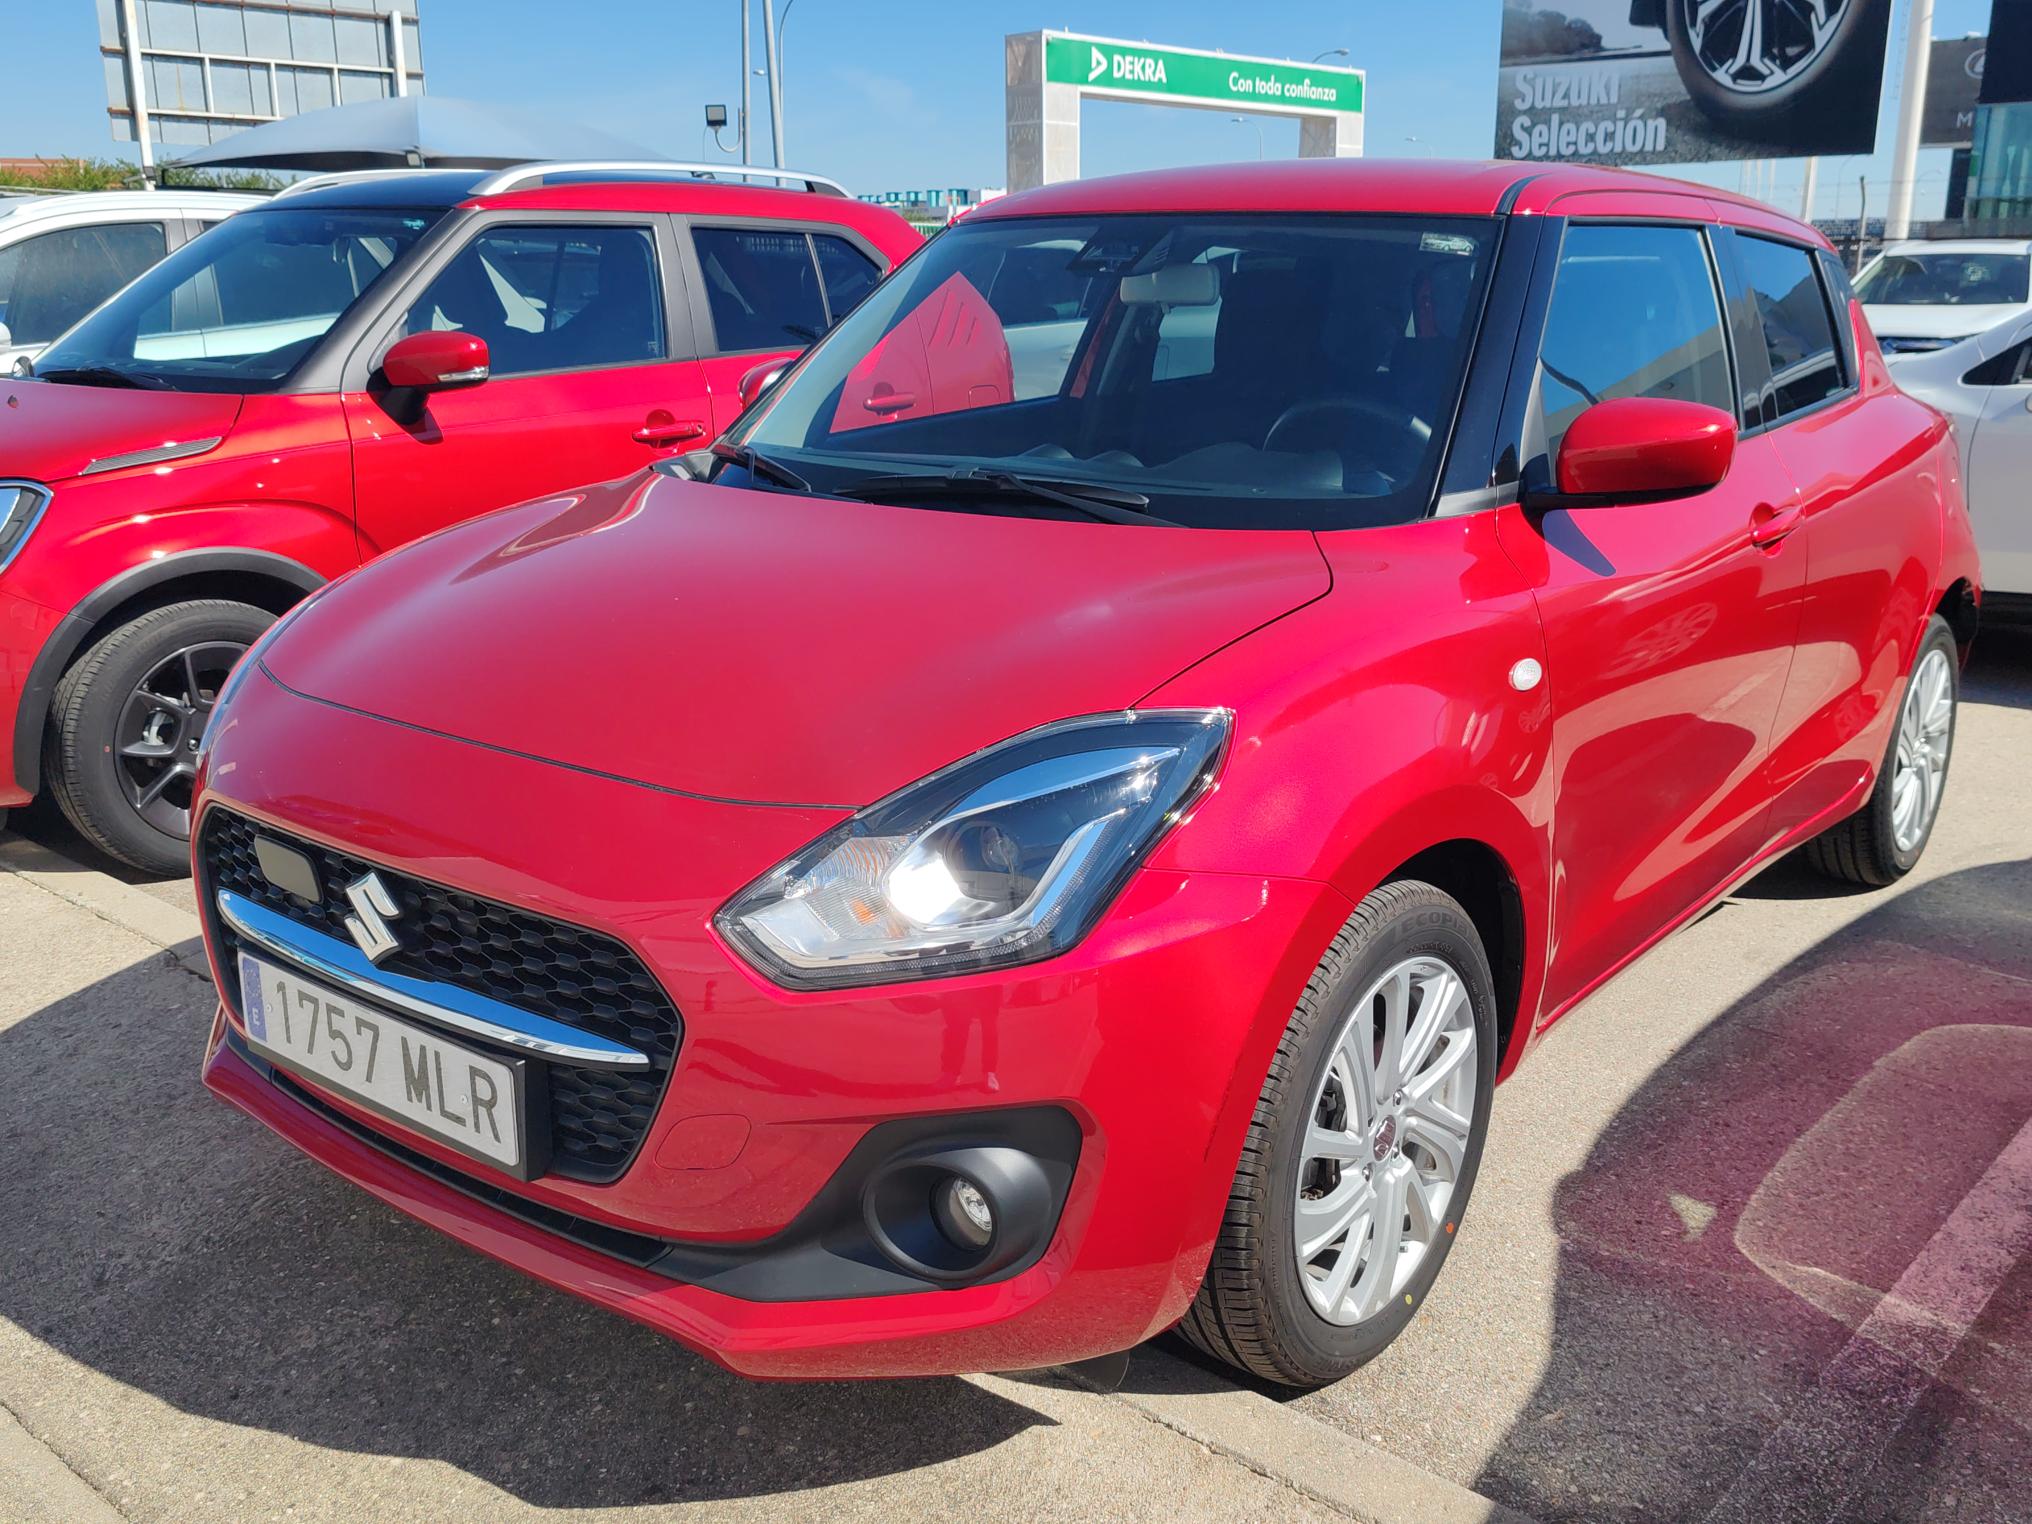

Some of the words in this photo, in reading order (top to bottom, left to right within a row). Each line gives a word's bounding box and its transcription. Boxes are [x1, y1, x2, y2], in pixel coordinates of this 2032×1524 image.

[1113, 54, 1168, 84] DEKRA
[1229, 72, 1253, 93] Con
[1255, 75, 1282, 97] toda
[1284, 79, 1337, 101] confianza
[1514, 70, 1621, 110] Suzuki
[1511, 108, 1667, 159] Selección
[251, 1008, 260, 1026] E
[276, 981, 380, 1084] 1757
[401, 1036, 502, 1144] MLR
